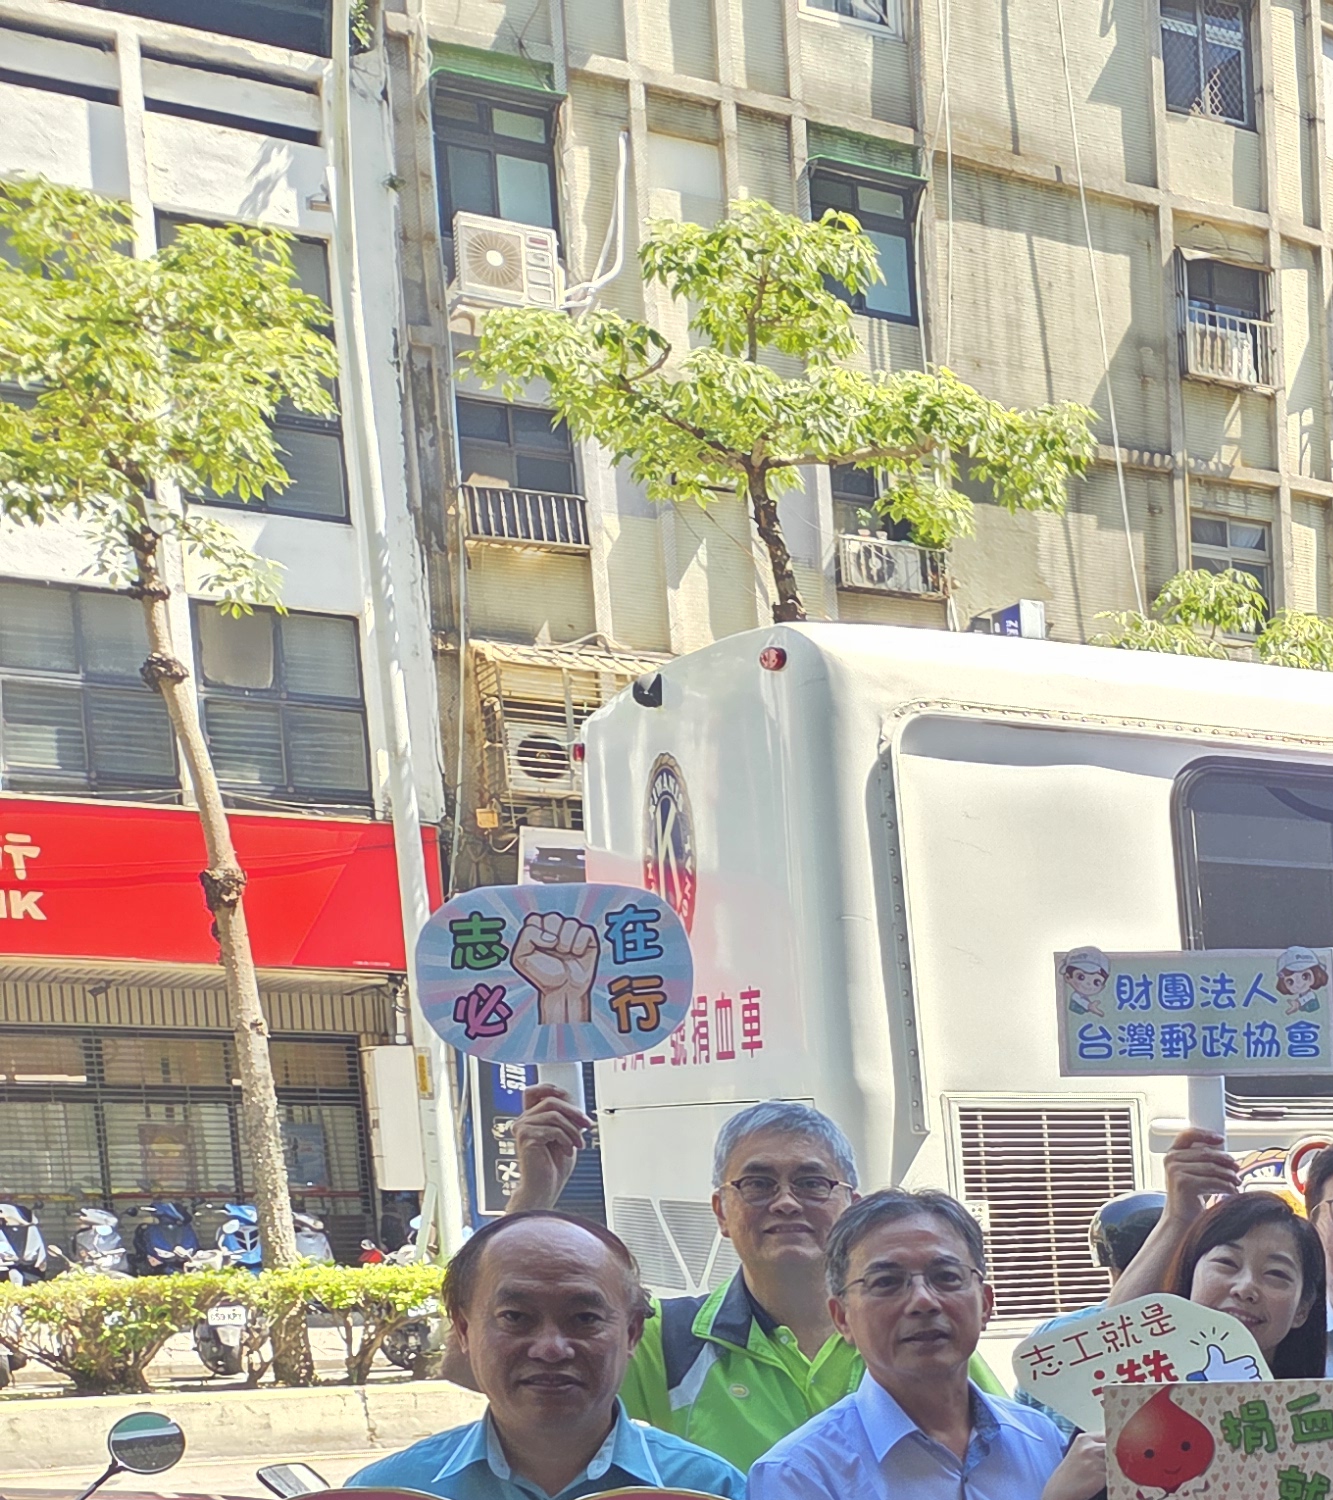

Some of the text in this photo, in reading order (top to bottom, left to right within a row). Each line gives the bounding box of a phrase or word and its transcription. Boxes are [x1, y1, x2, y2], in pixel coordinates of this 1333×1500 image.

[1115, 972, 1278, 1011] 財團法人
[1077, 1020, 1320, 1060] 台灣郵政協會
[1020, 1303, 1176, 1381] 志工就是
